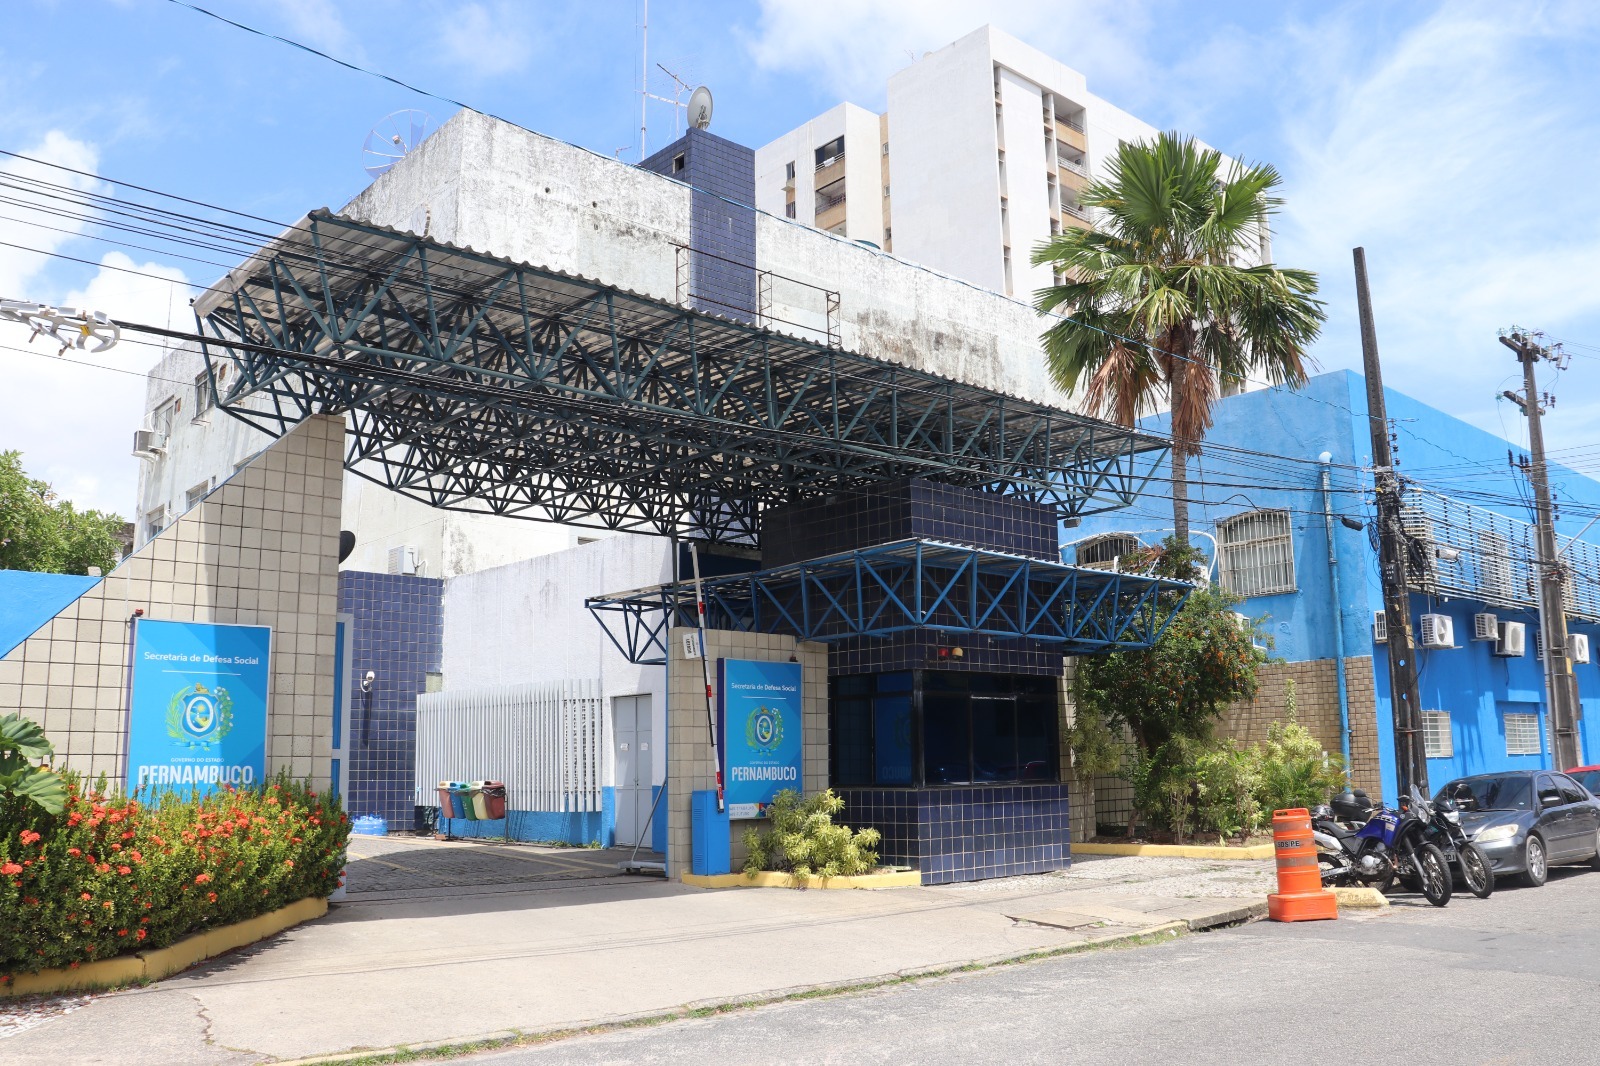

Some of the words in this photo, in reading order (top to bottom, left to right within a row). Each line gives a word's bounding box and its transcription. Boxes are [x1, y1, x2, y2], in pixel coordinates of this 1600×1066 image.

[144, 651, 188, 662] Secretaria
[190, 653, 201, 662] de
[203, 654, 232, 664] Defesa
[234, 656, 259, 665] Social
[731, 682, 756, 690] Secretaria
[138, 765, 254, 785] PERNAMBUCO
[731, 766, 797, 781] PERNAMBUCO
